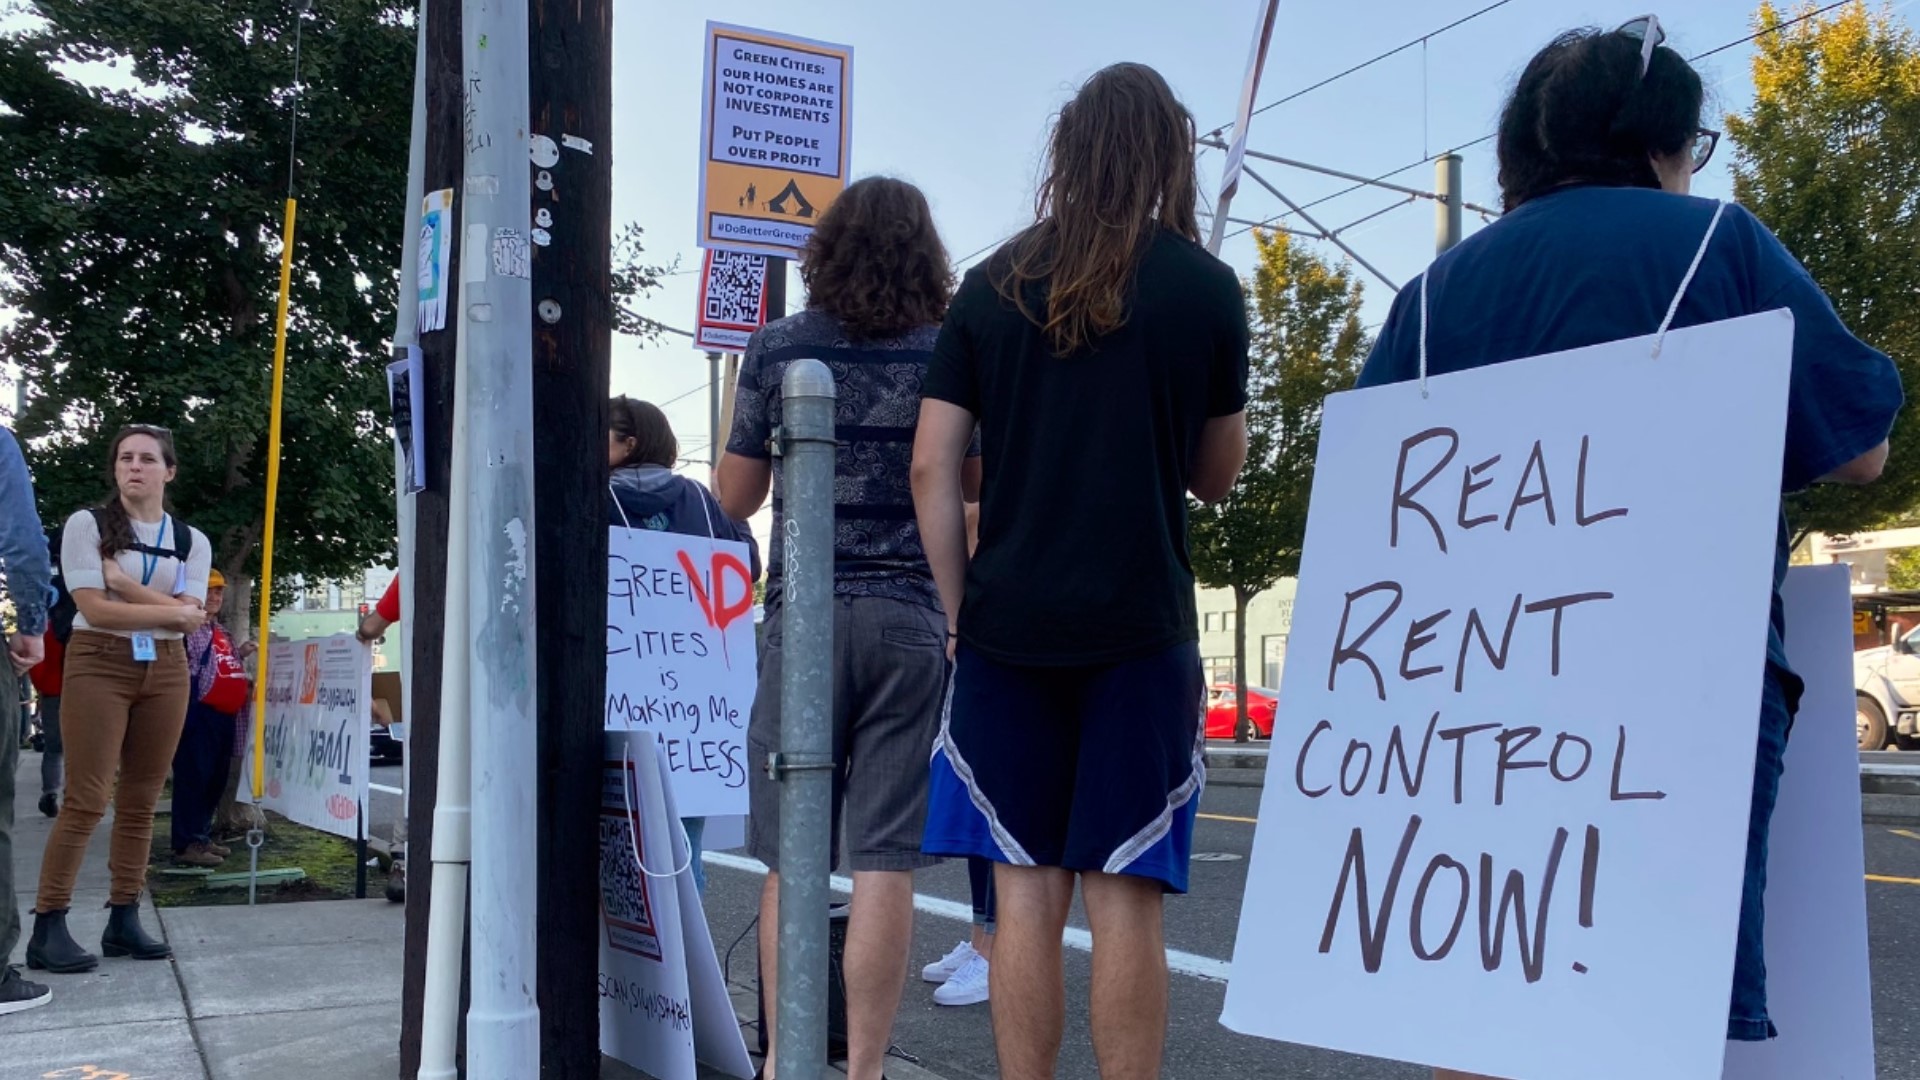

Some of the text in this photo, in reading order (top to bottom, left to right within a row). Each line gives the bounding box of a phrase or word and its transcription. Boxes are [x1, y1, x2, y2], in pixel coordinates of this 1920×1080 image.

[723, 68, 834, 94] OUR HOMES ARE
[723, 81, 834, 109] NOT CORPORATE
[726, 97, 830, 124] INVESTMENTS
[728, 146, 821, 168] OVER PROFIT
[718, 222, 814, 242] #DoBetterGreenC
[1390, 427, 1629, 553] REAL
[605, 625, 708, 660] CITIES
[1327, 580, 1614, 700] RENT
[659, 666, 678, 691] is
[607, 692, 743, 734] Making Me
[307, 719, 352, 785] Tyvek
[658, 732, 746, 788] ELESS
[1294, 711, 1667, 806] CONTROL
[1318, 815, 1599, 983] NOW!
